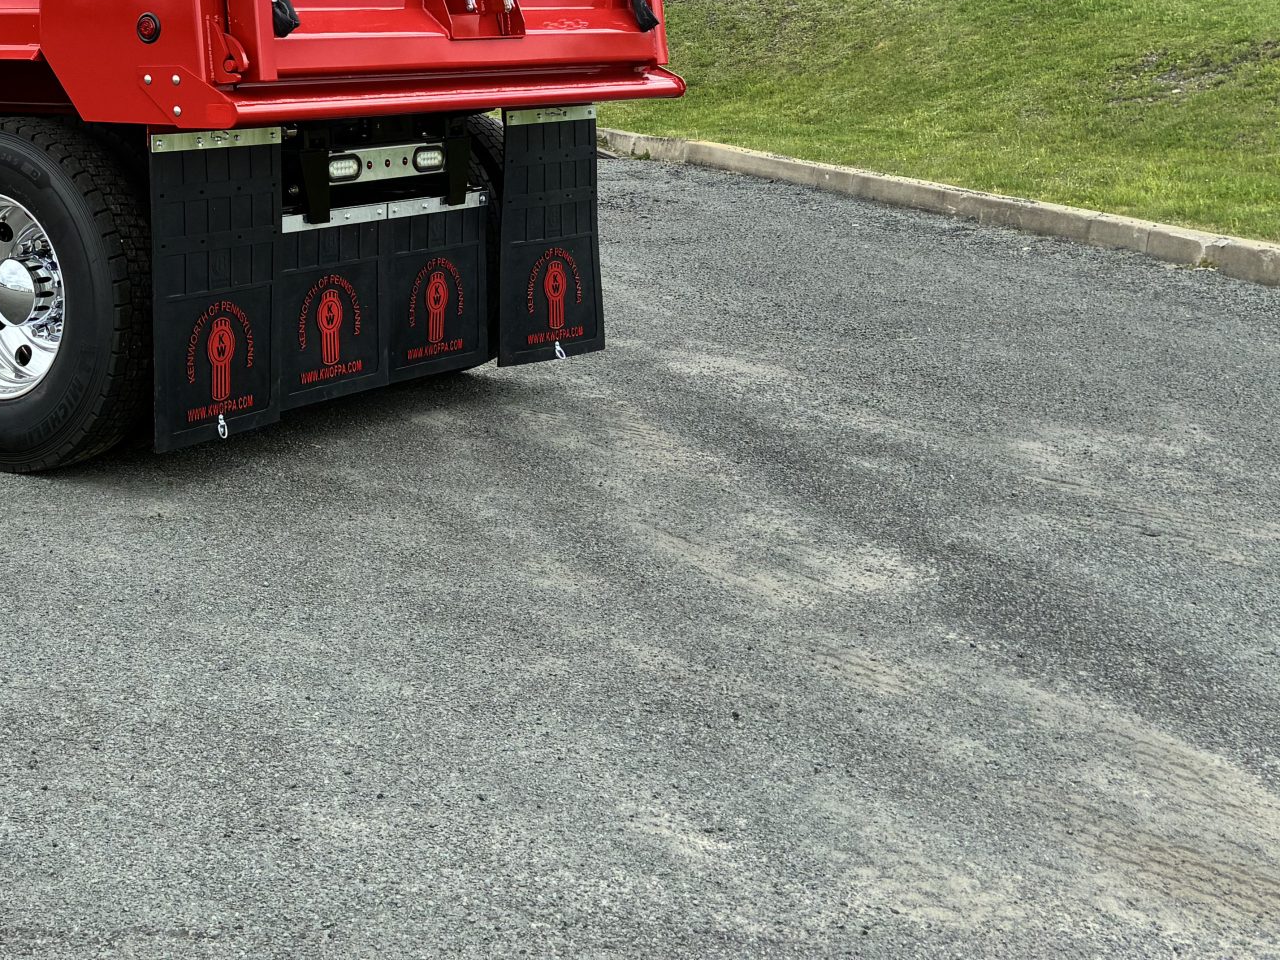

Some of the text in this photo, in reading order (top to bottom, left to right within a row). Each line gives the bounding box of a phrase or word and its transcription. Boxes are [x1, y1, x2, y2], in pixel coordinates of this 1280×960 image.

[409, 257, 464, 328] KENWORTH OF PENNSYLVANIA
[527, 247, 583, 314] KENWORTH OF PENNSYLVANIA
[298, 274, 361, 352] KENWORTH OF PENNSYLVANIA
[527, 326, 584, 345] WWW.KWOFPA.COM
[187, 300, 254, 384] KENWORTH OF PENNSYLVANIA
[407, 338, 464, 360] WWW.KWOFPA.COM
[300, 360, 363, 384] WWW.KWOFPA.COM
[187, 394, 254, 423] WWW.KWOFPA.COM
